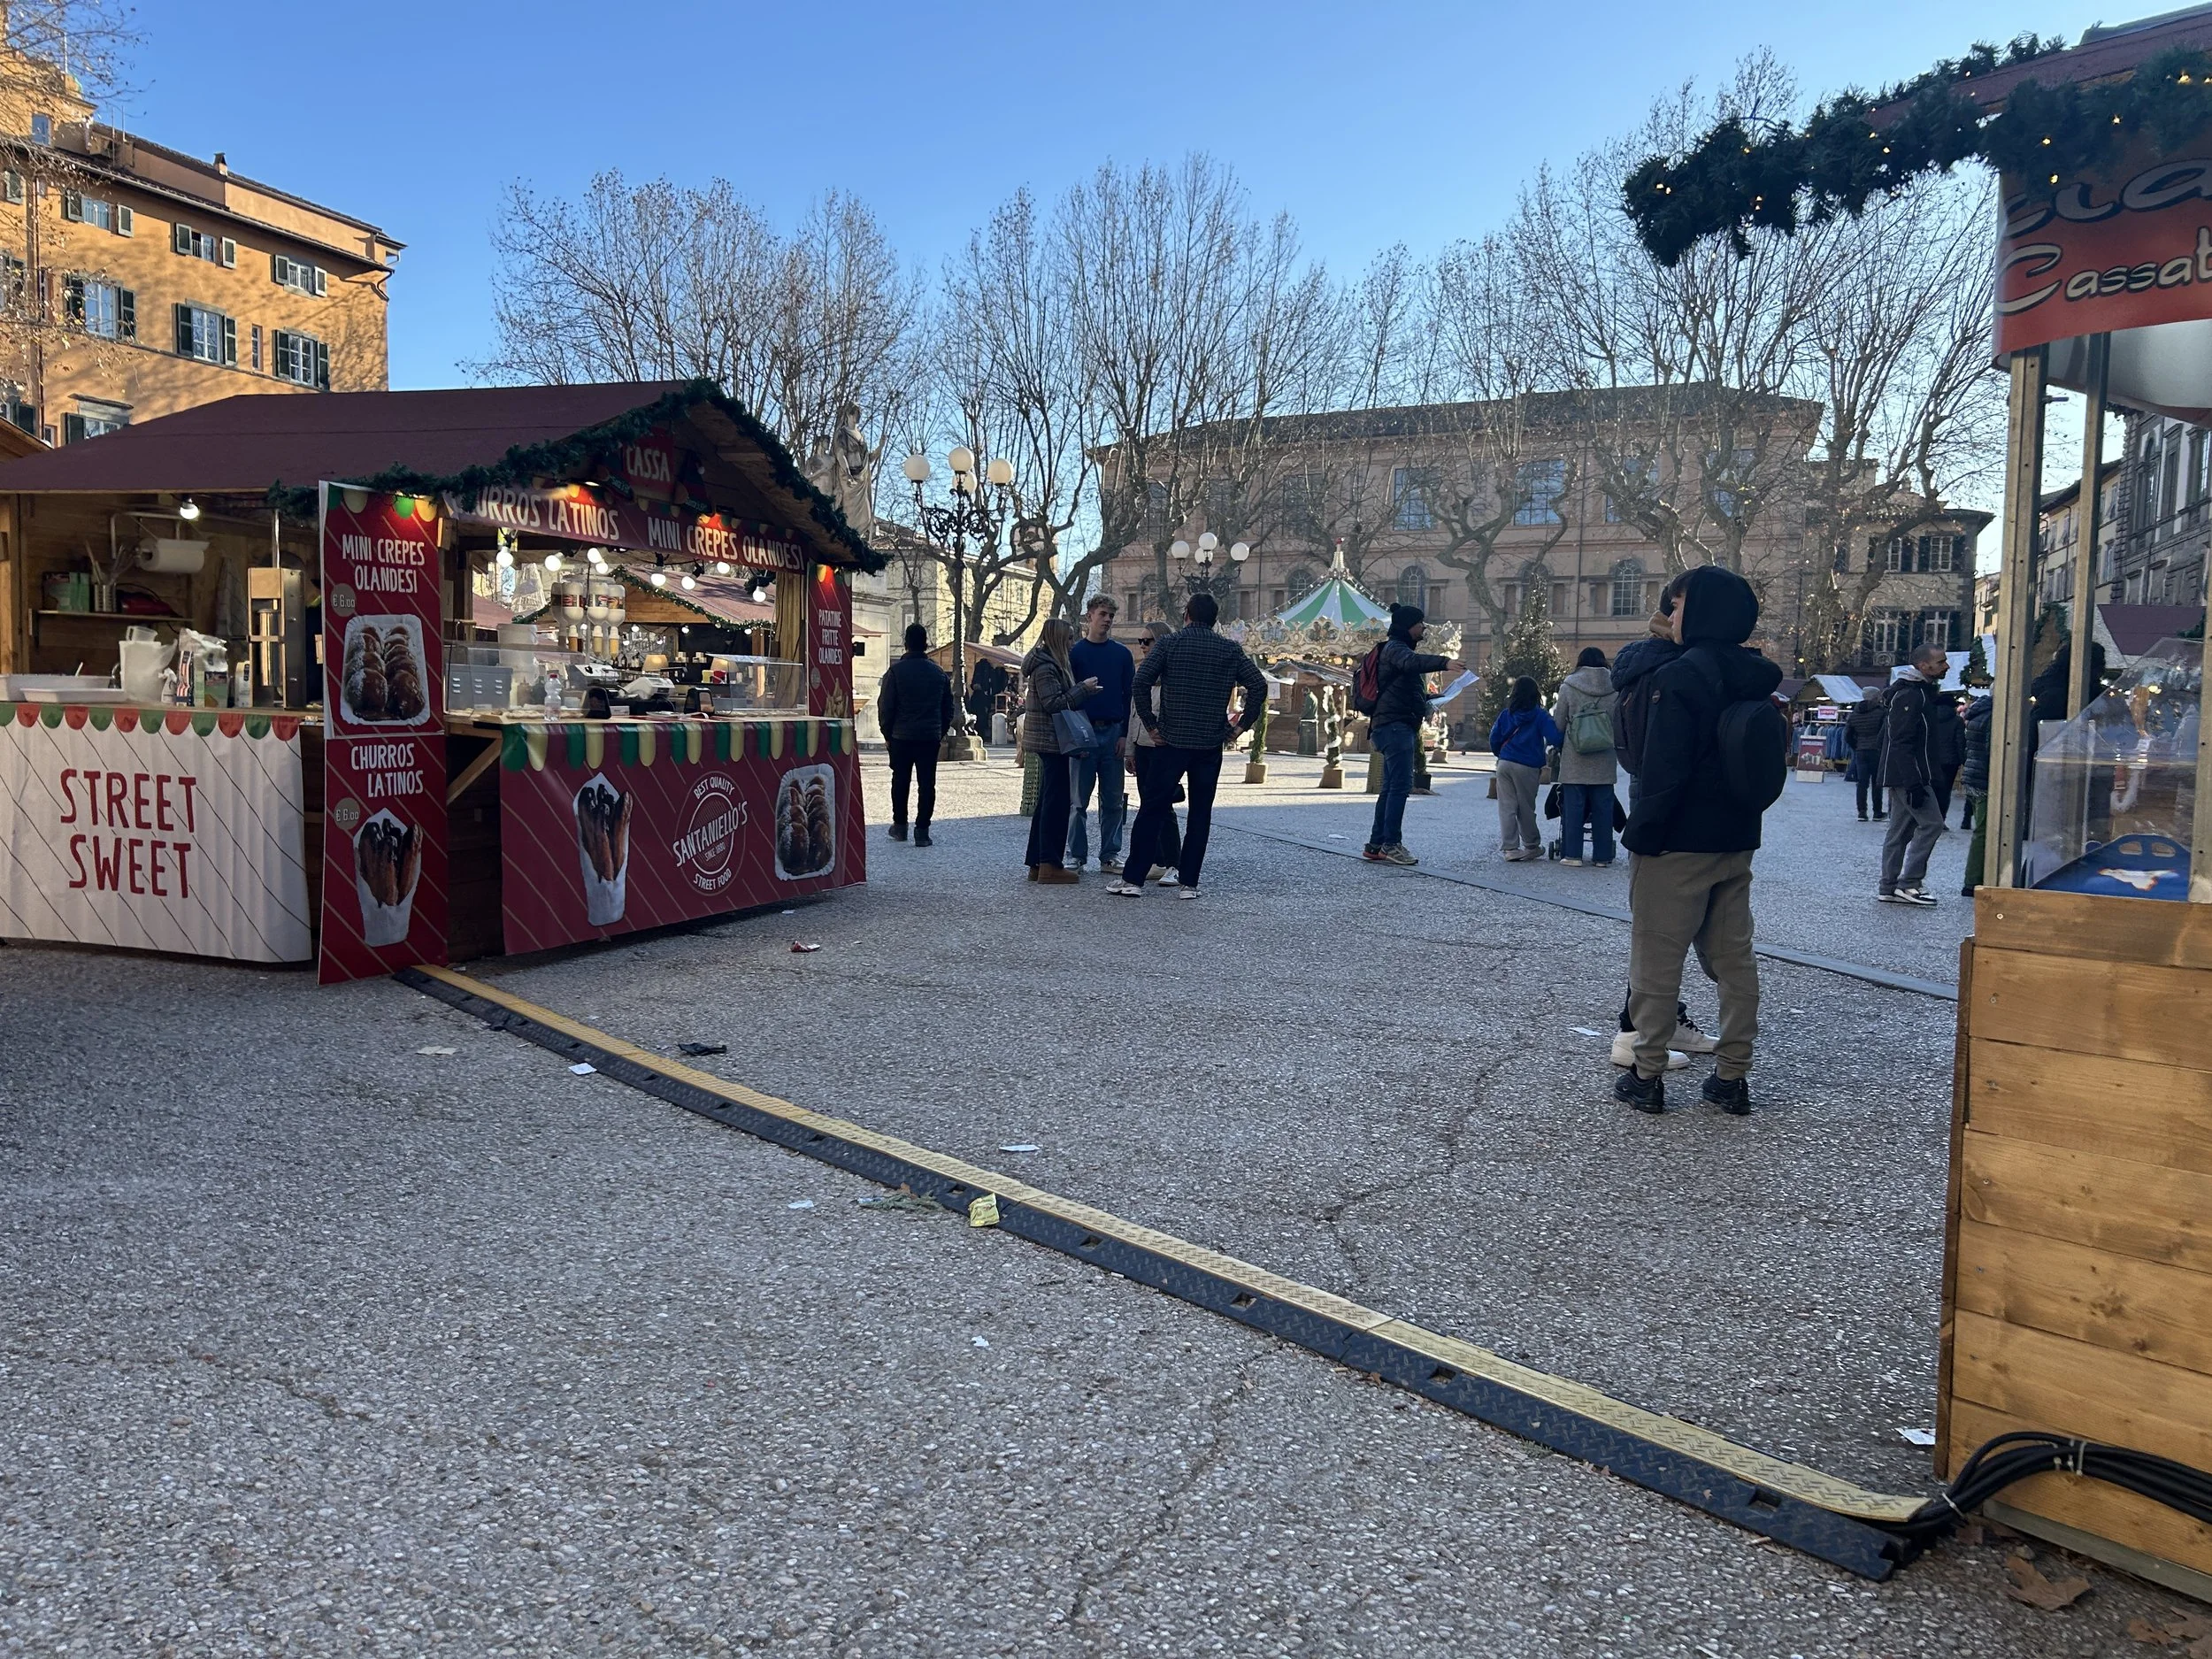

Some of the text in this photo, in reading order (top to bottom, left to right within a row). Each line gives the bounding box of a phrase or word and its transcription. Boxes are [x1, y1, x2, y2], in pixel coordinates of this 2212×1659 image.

[626, 445, 671, 482] CASSA
[469, 487, 620, 541] URROS LATINOS
[342, 534, 425, 565] MINI CREPES
[648, 516, 805, 571] MINI CREPES OLANDESI
[354, 565, 418, 594] OLANDESI
[818, 609, 842, 627] PATATINE
[821, 628, 839, 647] FRITTE
[818, 647, 843, 665] OLANDESI
[350, 742, 415, 771] CHURROS
[367, 770, 424, 798] LATINOS
[694, 776, 735, 799] BEST QUALITY
[60, 768, 196, 833] STREET
[672, 801, 748, 867] SANTANIELLO'S
[69, 833, 191, 899] SWEET
[694, 868, 732, 890] STREET FOOD
